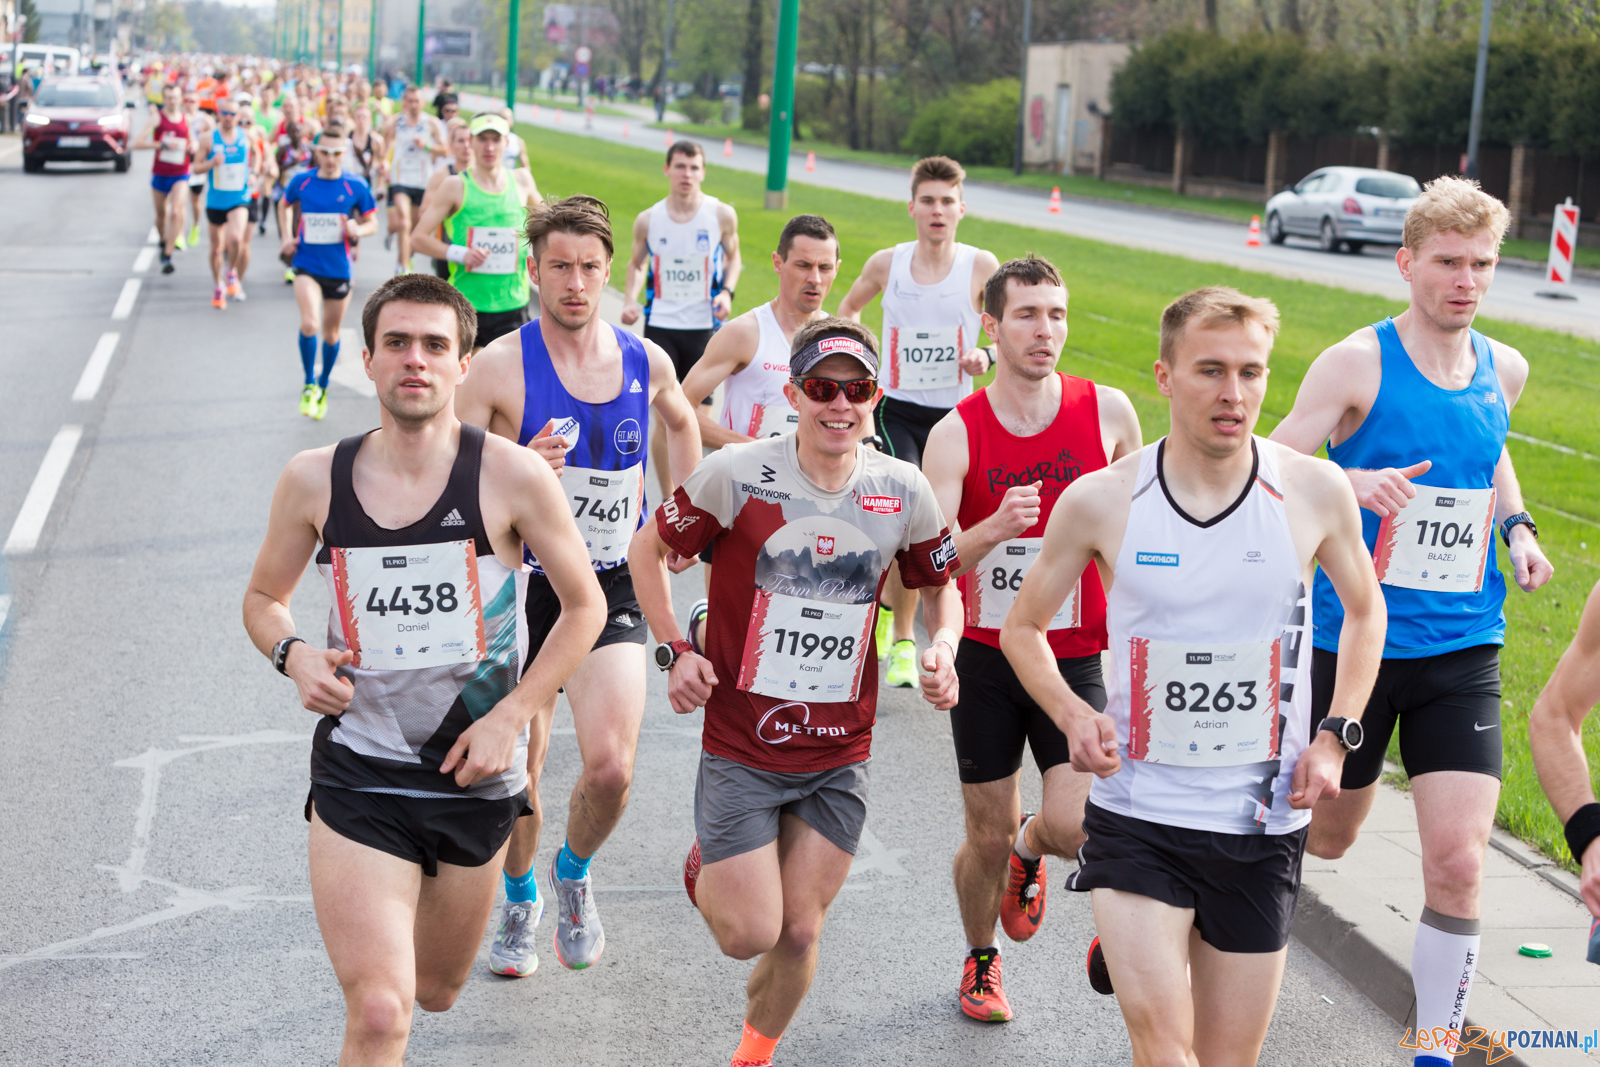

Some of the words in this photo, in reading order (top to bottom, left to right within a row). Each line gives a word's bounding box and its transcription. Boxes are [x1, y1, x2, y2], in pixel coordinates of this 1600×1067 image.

[665, 270, 701, 281] 11061
[822, 340, 861, 351] HAMMER
[903, 346, 955, 363] 10722
[617, 430, 627, 440] FIT
[741, 483, 791, 501] BODYWORK
[863, 497, 900, 508] HAMMER
[574, 496, 629, 523] 7461
[440, 519, 466, 527] adidas
[588, 524, 617, 535] Szymon
[1416, 520, 1473, 548] 1104
[1137, 554, 1178, 564] DECATHLON
[1427, 551, 1457, 562] BŁAŻEJ
[991, 566, 1024, 592] 86
[762, 571, 812, 597] Team
[817, 577, 873, 601] Polska
[366, 582, 459, 617] 4438
[397, 622, 430, 633] Daniel
[774, 628, 855, 661] 11998
[799, 664, 823, 673] Kamil
[1165, 680, 1257, 713] 8263
[1193, 719, 1229, 729] Adrian
